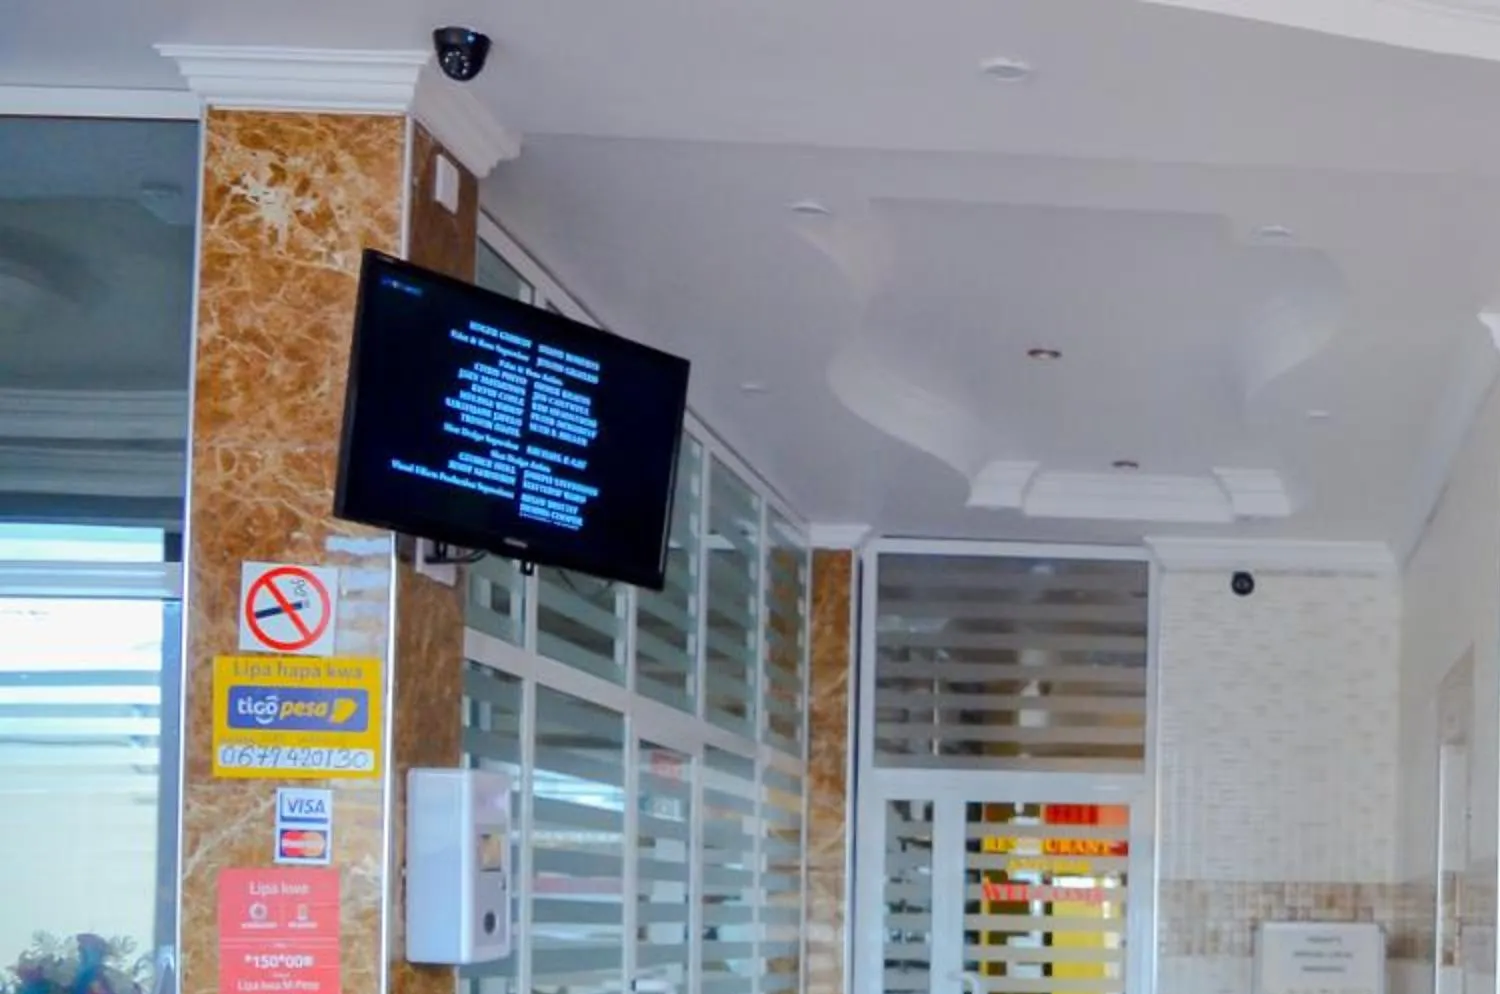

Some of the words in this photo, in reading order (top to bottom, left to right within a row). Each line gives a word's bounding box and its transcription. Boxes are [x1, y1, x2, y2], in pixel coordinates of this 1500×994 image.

[233, 661, 272, 680] Lipa
[277, 662, 321, 680] hapa
[326, 665, 364, 678] kwa
[237, 695, 278, 724] tigo
[279, 700, 328, 720] pesa
[288, 799, 326, 814] VISA
[249, 881, 279, 896] Lipa
[983, 878, 1105, 903] WELCOME
